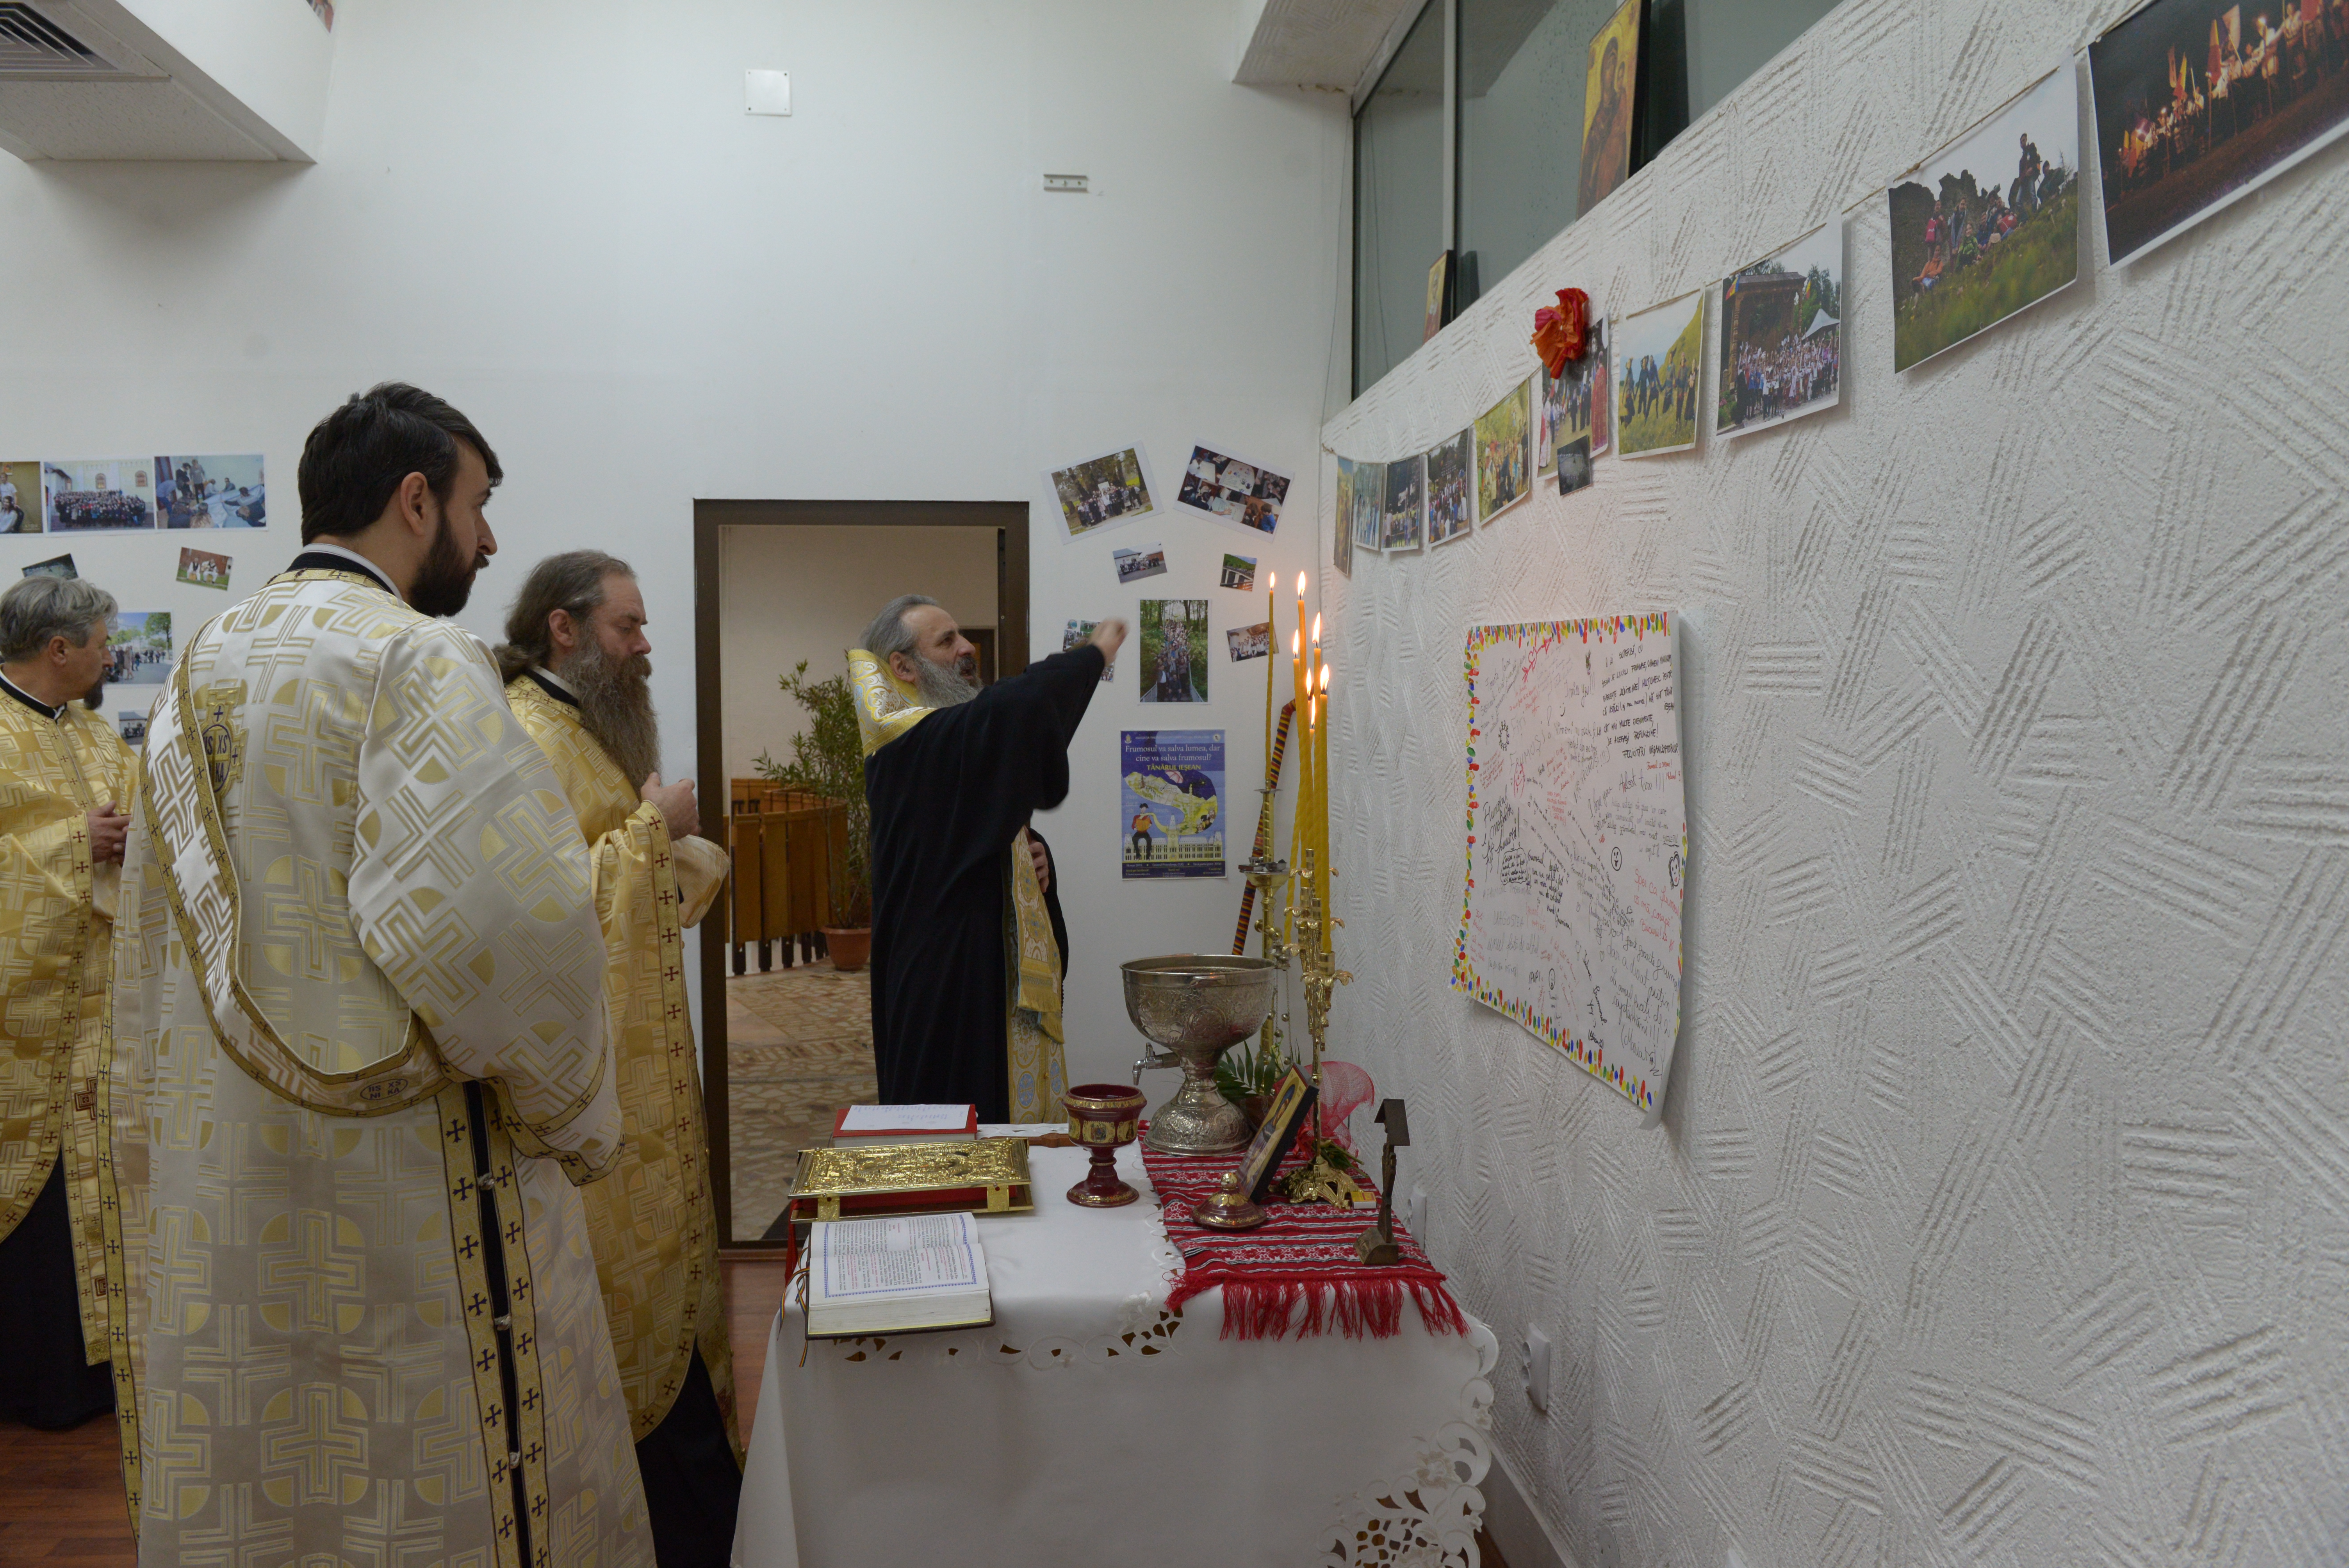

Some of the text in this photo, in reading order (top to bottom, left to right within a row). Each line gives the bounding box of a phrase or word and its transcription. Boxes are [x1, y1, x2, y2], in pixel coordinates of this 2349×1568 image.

[217, 734, 227, 754] XS
[1125, 744, 1157, 753] Frumosul
[1186, 744, 1207, 752] lumea,
[1147, 763, 1177, 771] TÂNĂRUL
[388, 1080, 402, 1088] XS
